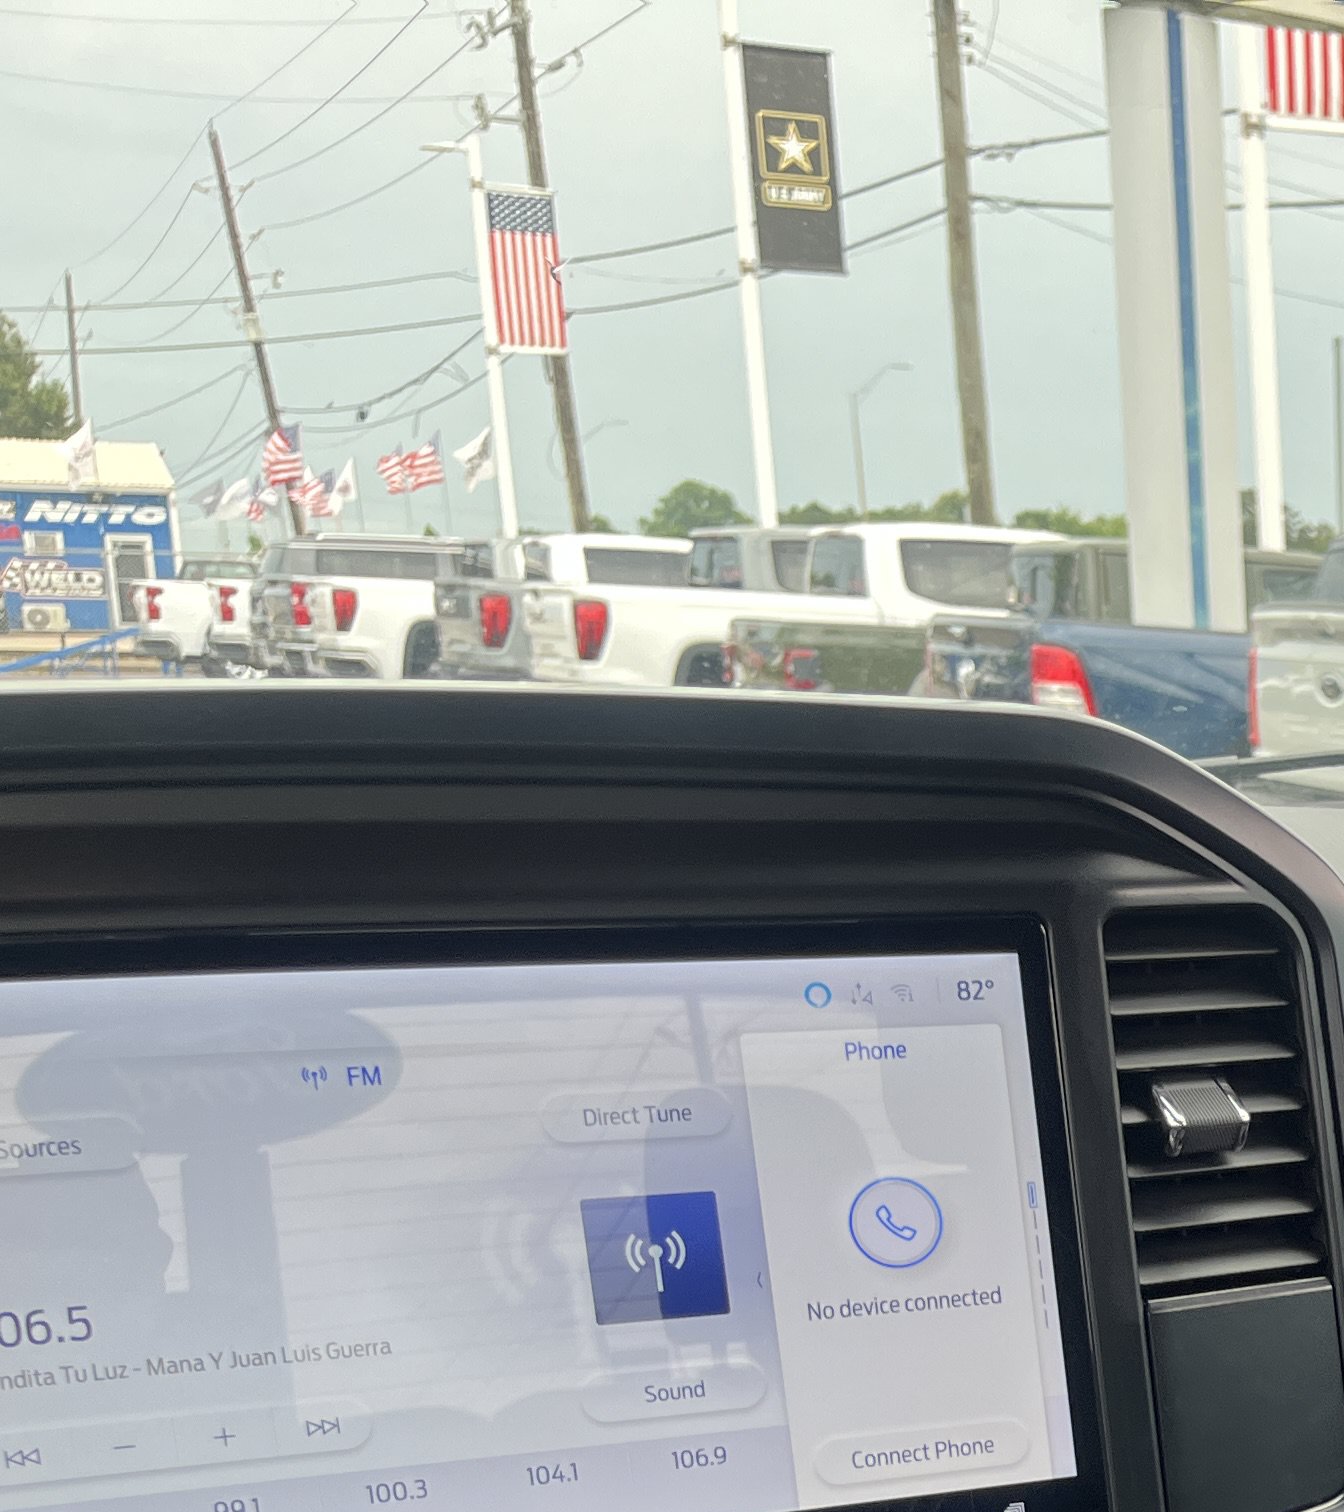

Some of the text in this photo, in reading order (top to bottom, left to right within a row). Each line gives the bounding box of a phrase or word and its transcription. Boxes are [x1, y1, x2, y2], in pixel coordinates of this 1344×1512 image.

[24, 500, 167, 525] NITTO
[844, 1040, 907, 1063] Phone
[346, 1065, 383, 1087] FM
[583, 1103, 693, 1128] Direct Tune
[807, 1287, 1002, 1322] No device connected
[58, 1365, 88, 1384] Tu
[92, 1362, 129, 1382] Luz
[147, 1357, 205, 1377] Mana
[208, 1352, 224, 1371] Y
[229, 1350, 277, 1370] Juan
[281, 1345, 322, 1365] Luis
[326, 1341, 392, 1361] Guerra
[644, 1380, 706, 1403] Sound
[671, 1445, 728, 1471] 106.9
[851, 1436, 996, 1471] Connect Phone
[526, 1462, 579, 1487] 104.1
[365, 1479, 429, 1504] 100.3
